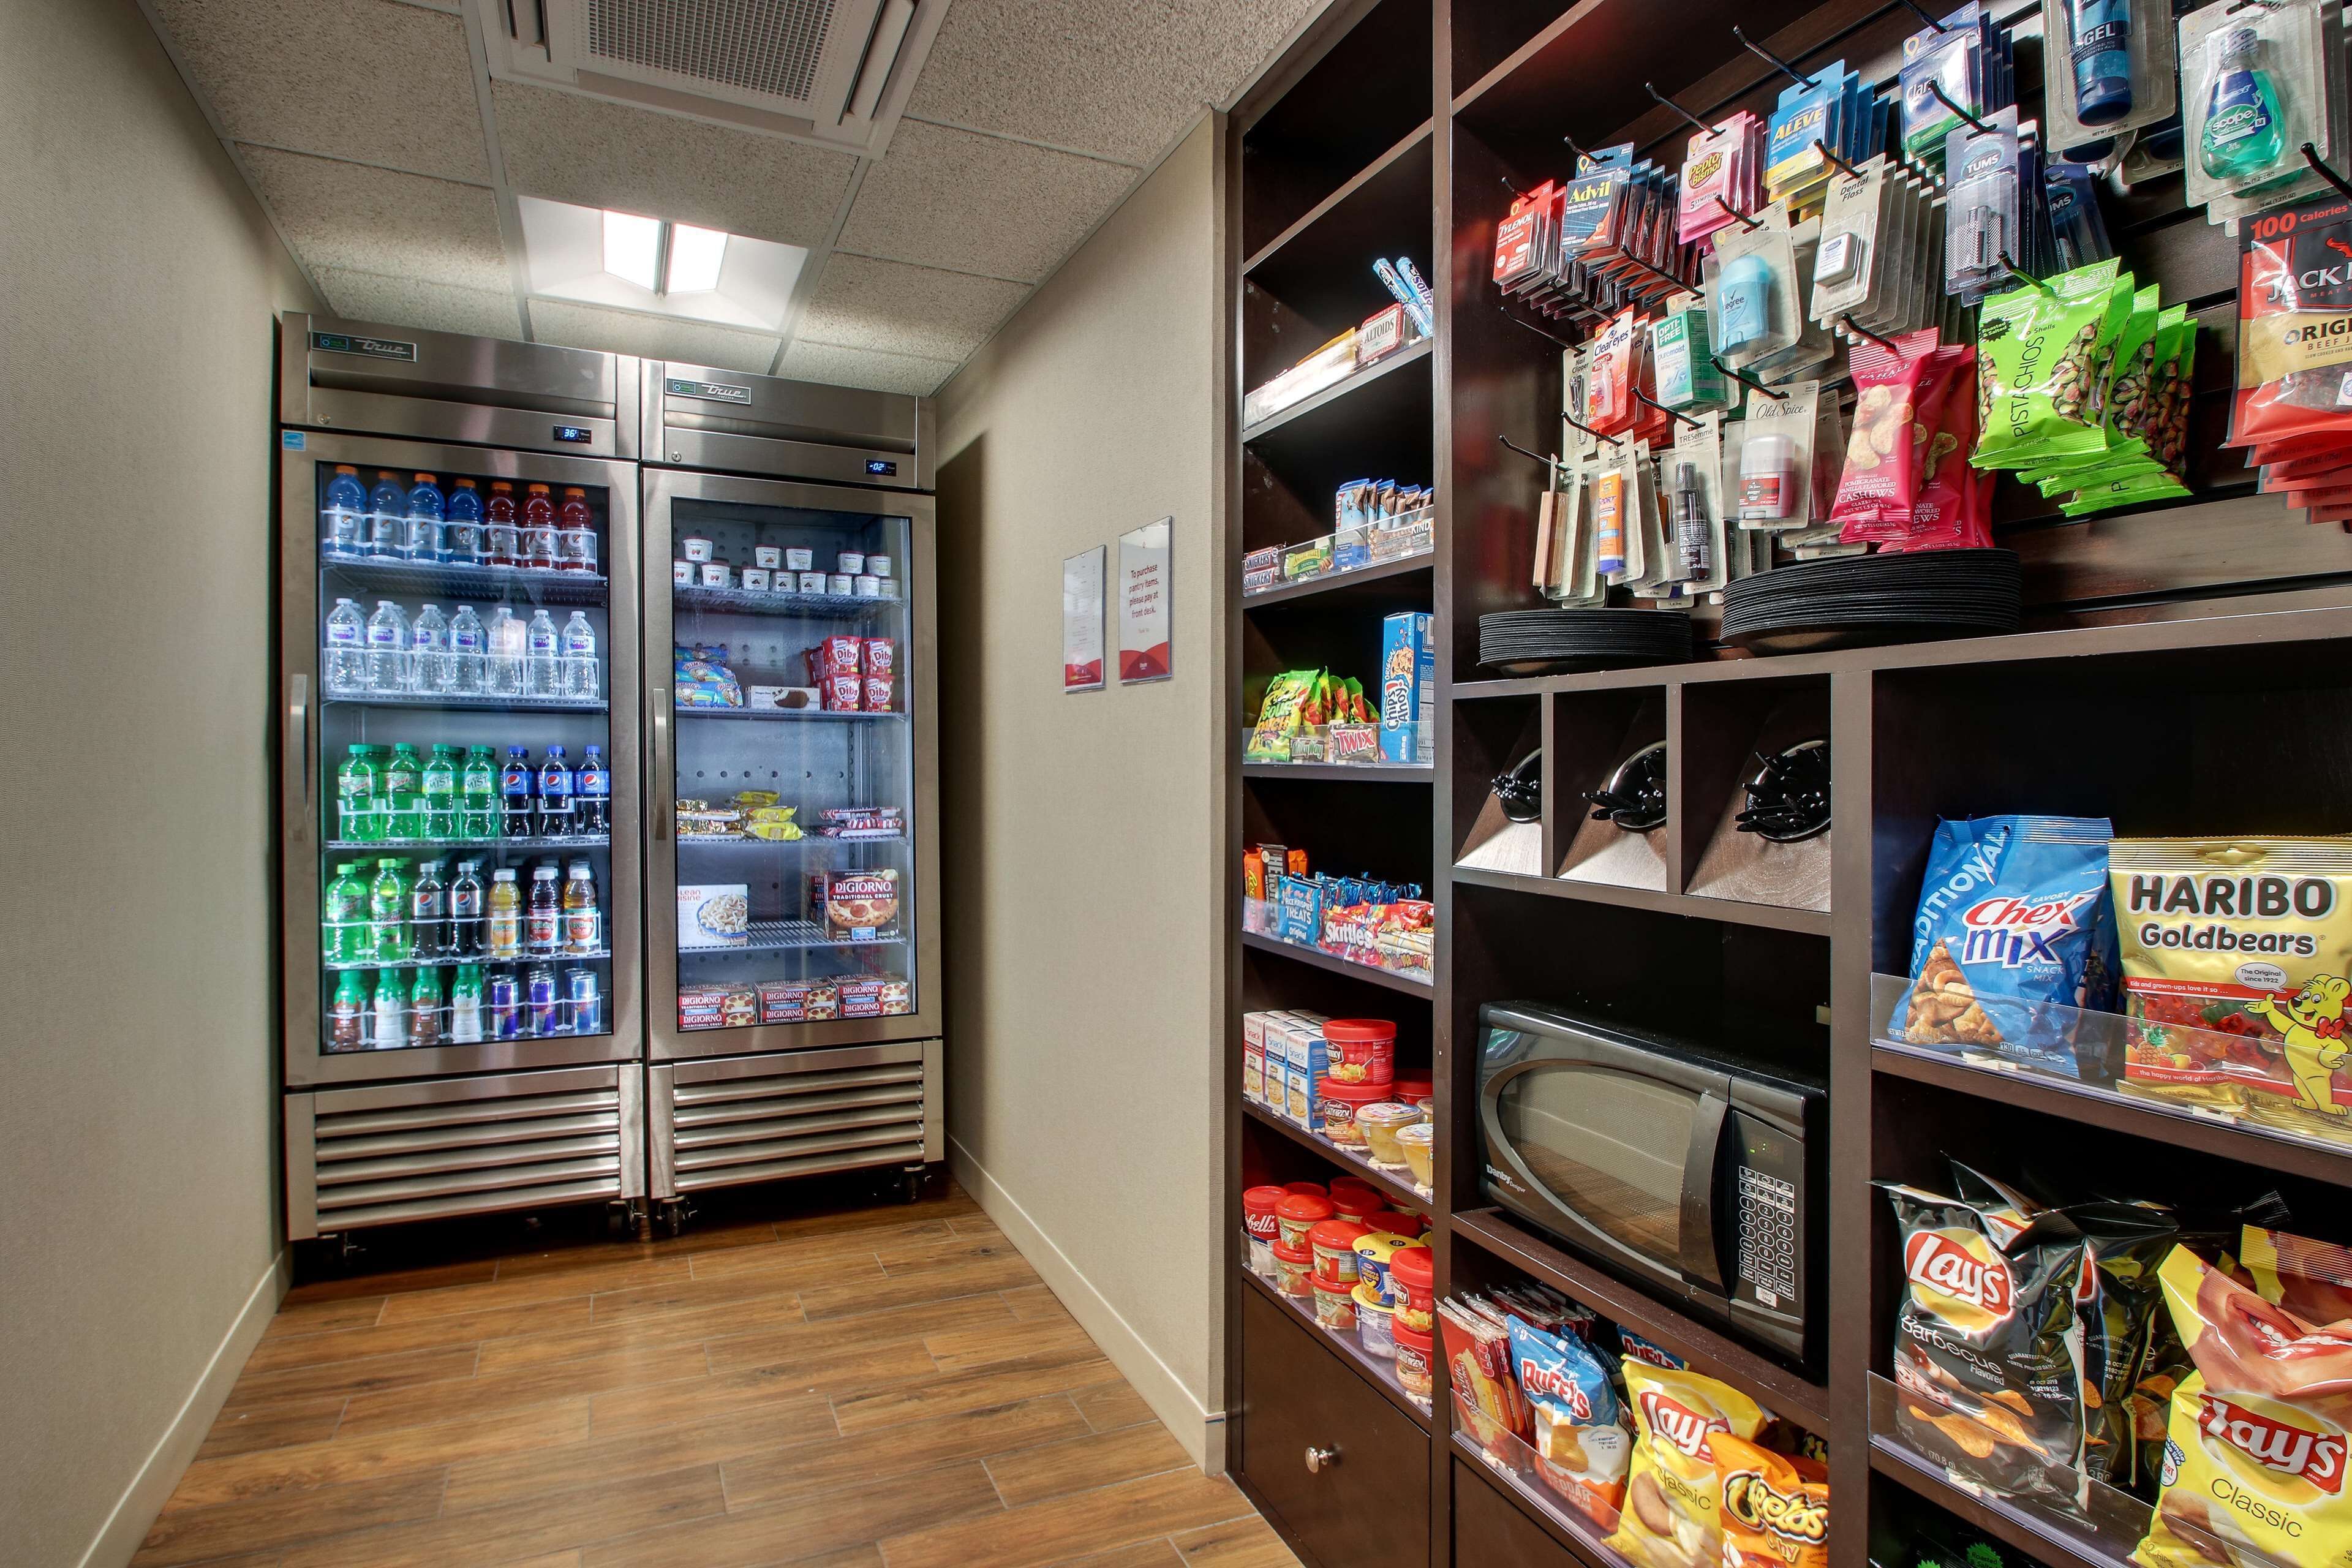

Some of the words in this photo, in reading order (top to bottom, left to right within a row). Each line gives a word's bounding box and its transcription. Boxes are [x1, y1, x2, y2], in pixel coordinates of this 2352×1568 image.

[1771, 107, 1825, 145] ALEVE
[2211, 109, 2253, 132] scope
[1689, 151, 1724, 181] Pepto-
[1692, 157, 1722, 187] Bismol
[1966, 155, 1999, 175] TUMS
[1567, 180, 1611, 204] Advil
[1839, 176, 1869, 195] Dental
[1695, 191, 1717, 205] SYMPTOM
[1842, 186, 1864, 203] Floss
[1499, 211, 1533, 239] TYLENOL
[2250, 212, 2297, 240] 100
[2300, 205, 2348, 223] calories
[1976, 275, 1987, 284] 500
[2267, 265, 2343, 303] JACK
[2310, 288, 2341, 298] MEAT
[1365, 317, 1395, 343] ALTOIDS
[1658, 318, 1680, 337] OPTI-
[1982, 320, 2006, 334] Roasted
[1987, 325, 2008, 337] Salted
[2034, 323, 2056, 334] Shells
[2283, 317, 2352, 346] ORIGI
[1594, 341, 1613, 357] Clear
[1612, 330, 1629, 349] eyes
[1659, 326, 1681, 346] FREE
[2308, 337, 2339, 351] BEEF
[1575, 356, 1586, 366] Nail
[1657, 344, 1686, 361] puremoist
[1572, 362, 1589, 374] Clipper
[1859, 361, 1912, 380] SAHALE
[2011, 336, 2045, 438] PISTACHIOS
[1756, 403, 1777, 419] Old
[1777, 401, 1804, 417] Spice
[1679, 429, 1714, 444] TRESemmé
[1839, 485, 1862, 494] VANILLA
[1845, 477, 1890, 487] POMEGRANATE
[1839, 488, 1895, 503] CASHEWS
[1411, 521, 1431, 535] KIND
[1246, 554, 1270, 570] SNICKERS
[1131, 570, 1136, 578] To
[1137, 564, 1158, 579] purchase
[1244, 570, 1272, 588] SNICKERS
[1129, 582, 1145, 595] pantry
[1129, 595, 1144, 608] please
[1144, 593, 1153, 603] pay
[1153, 590, 1158, 599] at
[1131, 609, 1144, 619] front
[837, 648, 857, 659] Dibs
[874, 650, 892, 661] Dibs
[1385, 649, 1396, 680] ORIGINAL
[839, 685, 858, 696] Dibs
[869, 687, 889, 697] Dibs
[1385, 690, 1400, 731] Chips
[1292, 741, 1310, 757] Milky
[1308, 741, 1324, 758] Way
[1335, 727, 1376, 756] TWIX
[835, 881, 892, 893] DIGIORNO
[2031, 891, 2071, 903] SAVORY
[2131, 875, 2332, 918] HARIBO
[1286, 906, 1312, 925] TREATS
[1965, 895, 2087, 927] Chex
[1324, 920, 1374, 949] Skittles
[2140, 922, 2314, 954] Goldbears
[2026, 965, 2064, 974] SNACK
[2152, 982, 2186, 992] grown-ups
[1246, 1027, 1261, 1040] Snack
[1268, 1036, 1284, 1049] Snack
[2000, 1042, 2013, 1051] 130
[1289, 1047, 1305, 1061] Snack
[2139, 1069, 2150, 1077] the
[2151, 1071, 2172, 1080] happy
[2203, 1074, 2230, 1082] Haribo
[1486, 1164, 1510, 1185] Danby
[1246, 1214, 1277, 1233] bell's
[1909, 1234, 2006, 1305] Lay's
[1900, 1314, 2003, 1375] Barbecue
[2010, 1360, 2024, 1369] UNTIL
[2040, 1354, 2054, 1364] FRESH
[1970, 1363, 2005, 1387] Flavored
[2209, 1400, 2345, 1479] Lay's
[1928, 1450, 1949, 1467] (70.8
[2306, 1472, 2321, 1483] BRAND
[2210, 1478, 2302, 1539] Classic
[1972, 1552, 1998, 1564] Roasted
